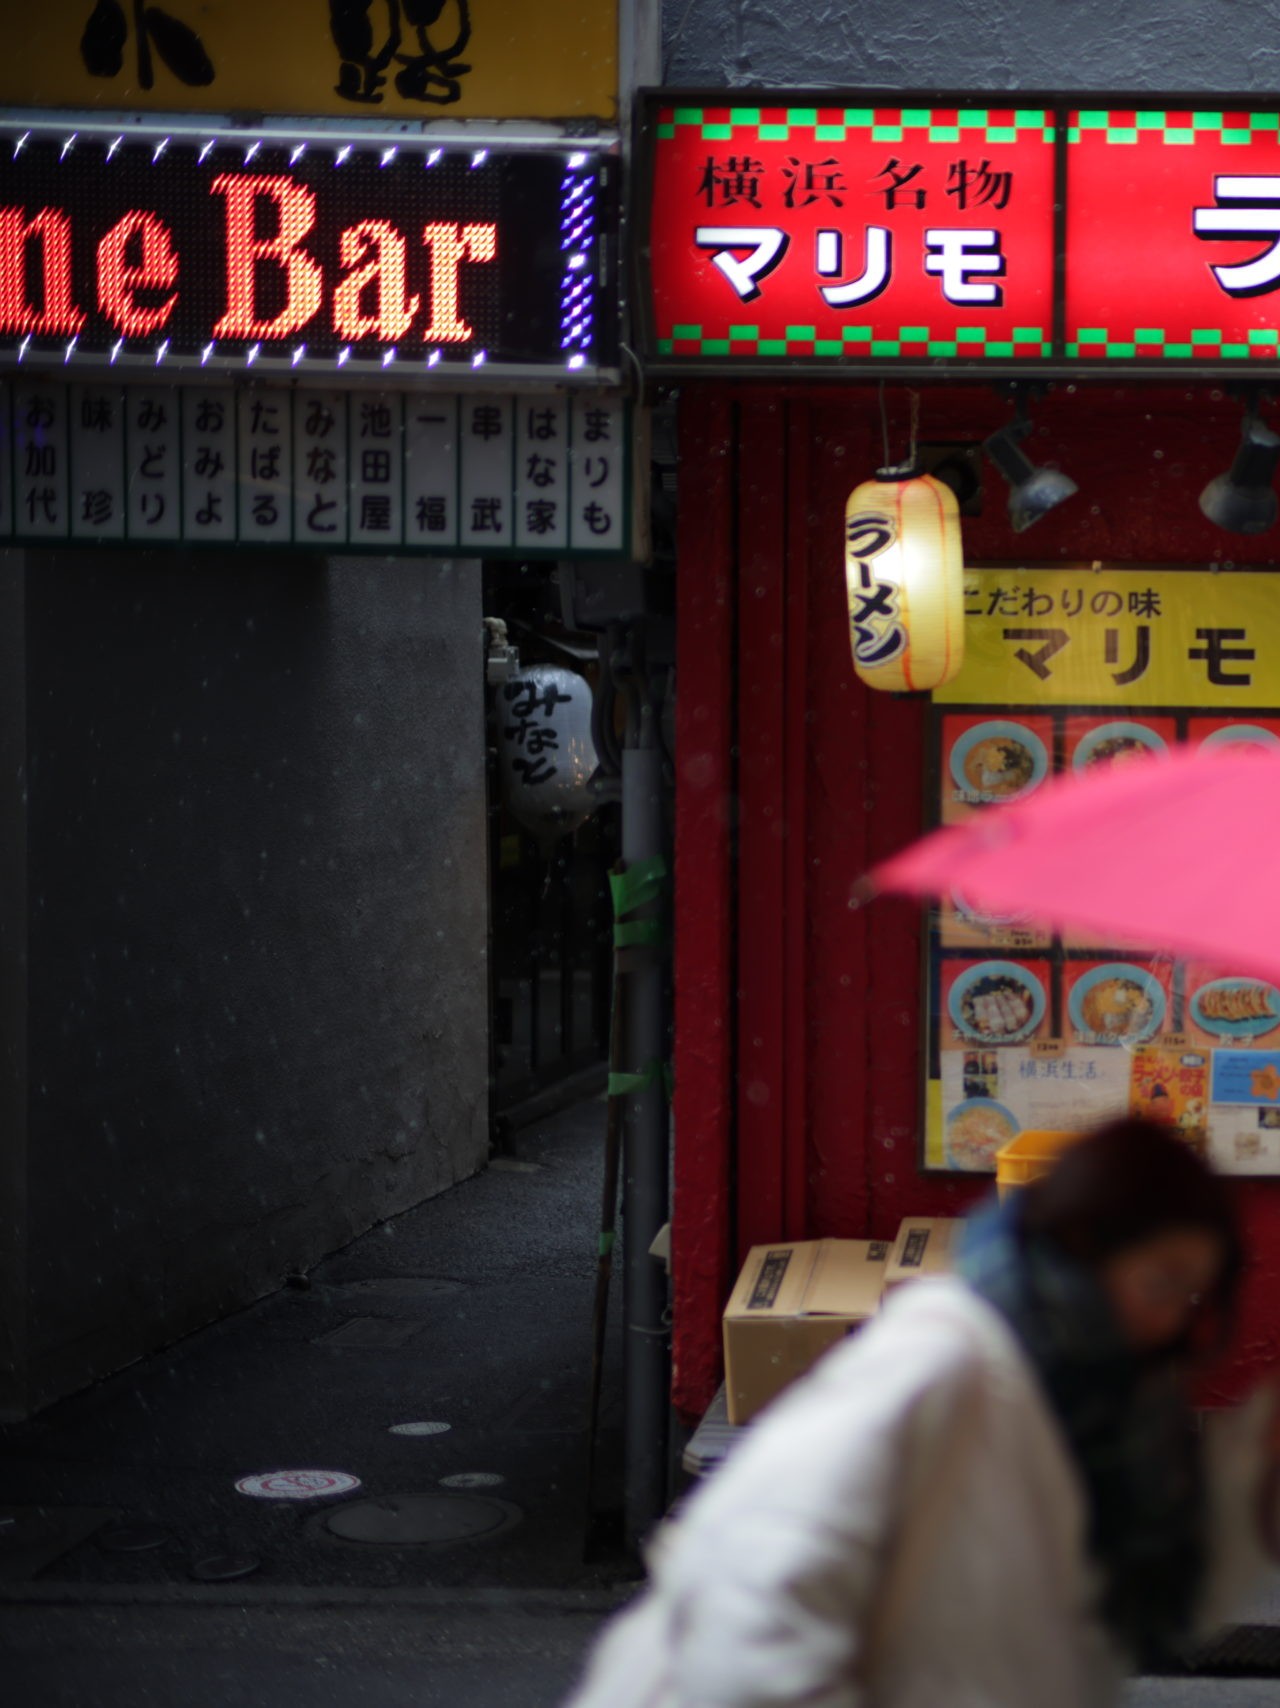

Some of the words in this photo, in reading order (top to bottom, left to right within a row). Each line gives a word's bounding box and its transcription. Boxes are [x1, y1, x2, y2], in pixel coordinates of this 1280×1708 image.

[696, 156, 1013, 210] 横浜名物
[210, 173, 497, 342] Bar
[695, 226, 1007, 309] マリモ
[25, 395, 57, 524] お加代
[81, 401, 112, 525] 味珍
[138, 400, 166, 524] みどり
[194, 401, 223, 525] おみよ
[250, 401, 280, 526] たばる
[305, 401, 337, 532] みなと
[360, 402, 391, 531] 池田屋
[417, 414, 446, 530] 一福
[471, 406, 502, 532] 串武
[527, 409, 557, 534] はな家
[583, 410, 612, 535] まりも
[848, 517, 903, 666] ラーメン
[1002, 625, 1256, 686] マリモ
[503, 680, 572, 785] みなと
